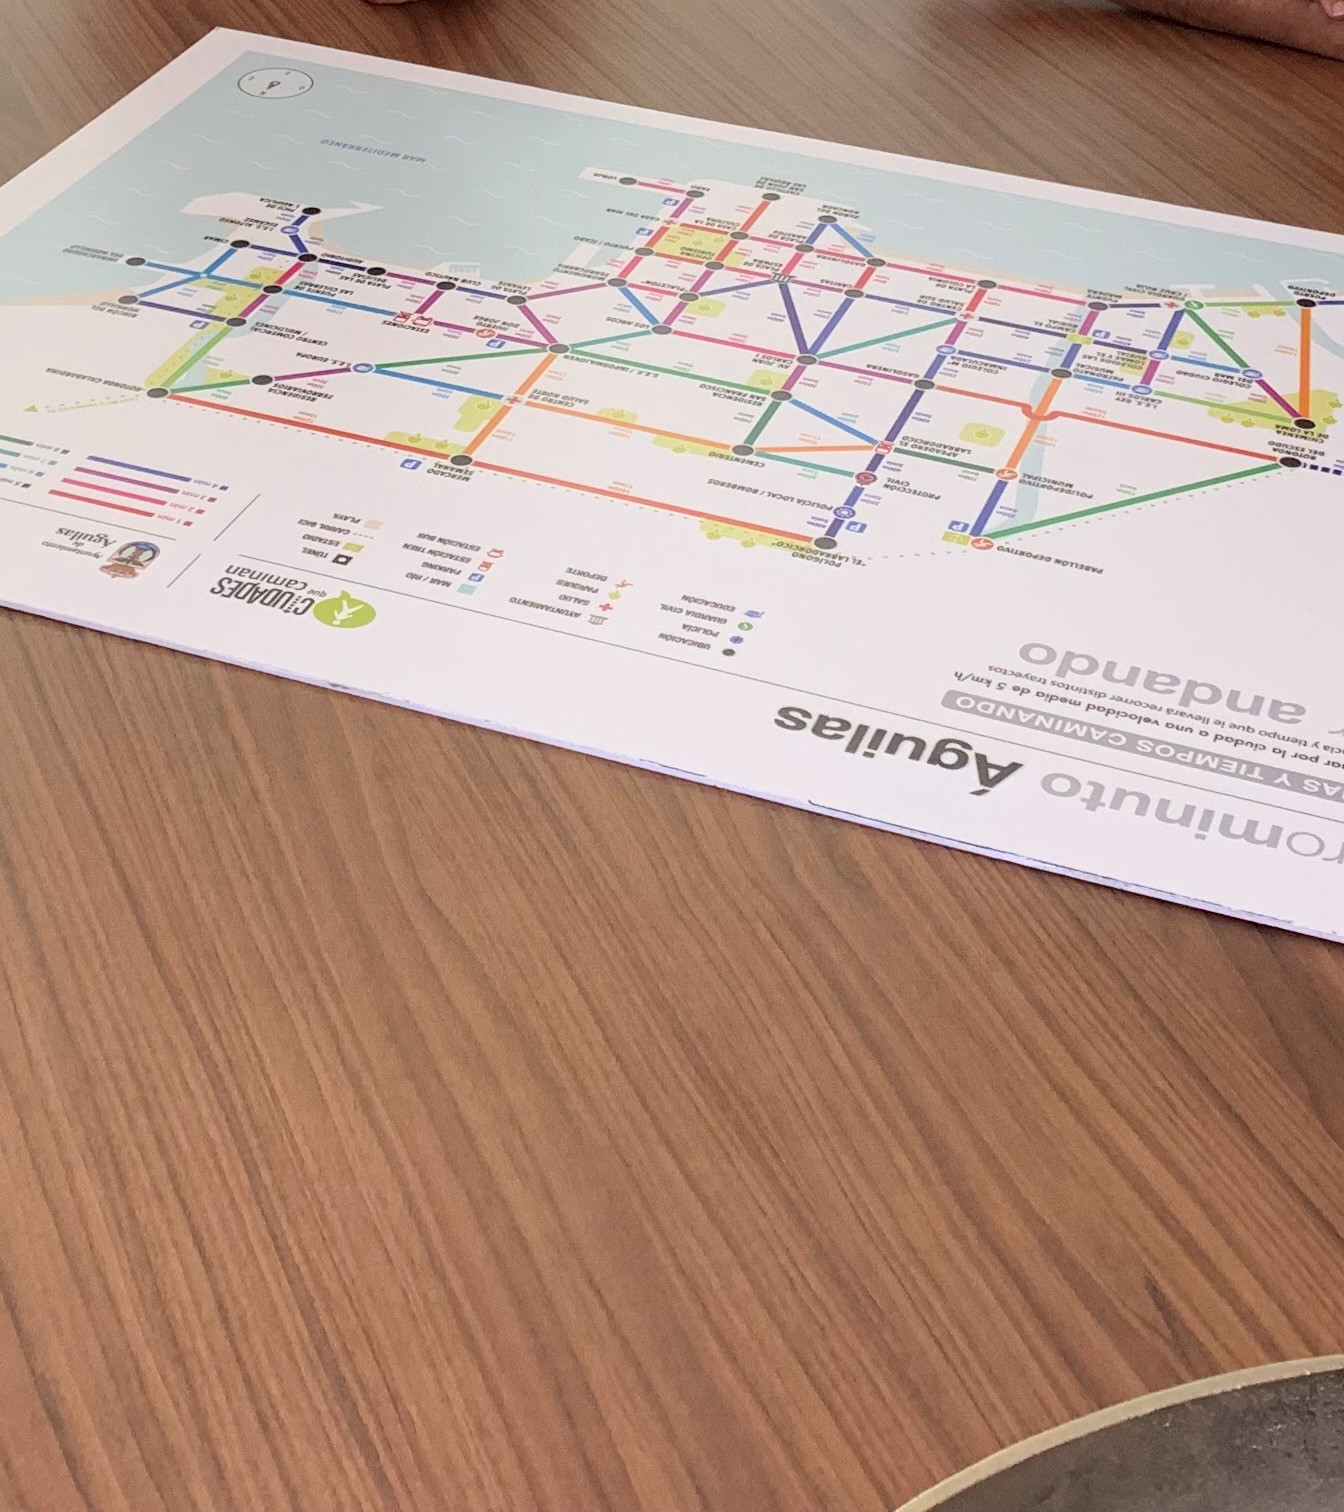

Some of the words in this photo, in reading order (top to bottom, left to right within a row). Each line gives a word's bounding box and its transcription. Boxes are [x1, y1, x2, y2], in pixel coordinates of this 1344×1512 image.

[402, 154, 426, 164] MAR
[382, 320, 430, 333] ESTACIONES
[605, 316, 633, 326] ARCOS
[635, 321, 650, 329] LOS
[296, 351, 329, 363] EUROPA
[865, 363, 920, 379] GASOLINERA
[1213, 377, 1252, 389] COLEGIO
[699, 383, 748, 399] FRANCISCO
[749, 392, 767, 402] SAN
[712, 391, 763, 407] RESIDENCIA
[1267, 440, 1303, 452] ESCUDO
[1272, 446, 1316, 461] ROTONDA
[1305, 448, 1325, 457] DEL
[708, 451, 765, 468] CEMENTERIO
[426, 468, 471, 482] MERCADO
[433, 462, 475, 476] SEMANAL
[707, 478, 758, 495] BOMBEROS
[886, 477, 910, 488] CIVIL
[1021, 472, 1074, 489] MUNICIPAL
[883, 483, 941, 500] PROTECCIÓN
[1018, 478, 1094, 499] POLIDEPORTIVO
[767, 490, 794, 504] LOCAL
[796, 496, 833, 511] POLICÍA
[333, 513, 361, 524] PLAYA
[55, 527, 117, 549] Águilas
[302, 534, 341, 547] ESTADIO
[416, 532, 436, 542] BUS
[438, 537, 481, 552] ESTACIÓN
[40, 541, 104, 560] Ayuntamiento
[301, 547, 329, 558] TÚNEL
[403, 543, 426, 554] TREN
[996, 545, 1052, 564] DEPORTIVO
[427, 549, 472, 564] ESTACIÓN
[791, 551, 841, 568] POLÍGONO
[421, 561, 462, 576] PARKING
[1054, 557, 1104, 575] PABELLÓN
[224, 564, 308, 590] caminan
[429, 577, 452, 587] MAR
[565, 567, 608, 582] DEPORTE
[306, 588, 327, 597] que
[556, 579, 599, 594] PARQUES
[508, 596, 582, 619] AYUNTAMIENTO
[558, 594, 590, 606] SALUD
[680, 594, 736, 613] EDUCACIÓN
[660, 603, 683, 614] CIVIL
[685, 610, 727, 625] GUARDIA
[682, 623, 719, 638] POLICÍA
[657, 632, 711, 650] UBICACIÓN
[954, 670, 993, 688] km/h
[988, 665, 1048, 688] trayectos
[996, 681, 1007, 692] 5
[1019, 643, 1307, 726] andando
[1050, 680, 1107, 702] distintos
[1011, 686, 1031, 699] de
[1035, 691, 1082, 709] media
[1110, 693, 1163, 712] recorrer
[956, 694, 1127, 745] CAMINANDO
[1085, 704, 1159, 729] velocidad
[1166, 708, 1211, 730] llevará
[1165, 721, 1193, 736] una
[1214, 719, 1226, 732] le
[1228, 720, 1255, 736] que
[1198, 730, 1209, 739] a
[1259, 728, 1309, 750] tiempo
[1213, 733, 1267, 754] ciudad
[1310, 740, 1320, 750] y
[774, 707, 1024, 797] Águilas
[1135, 737, 1264, 780] TIEMPOS
[1272, 747, 1287, 760] la
[1291, 749, 1319, 765] por
[1273, 771, 1291, 787] Y
